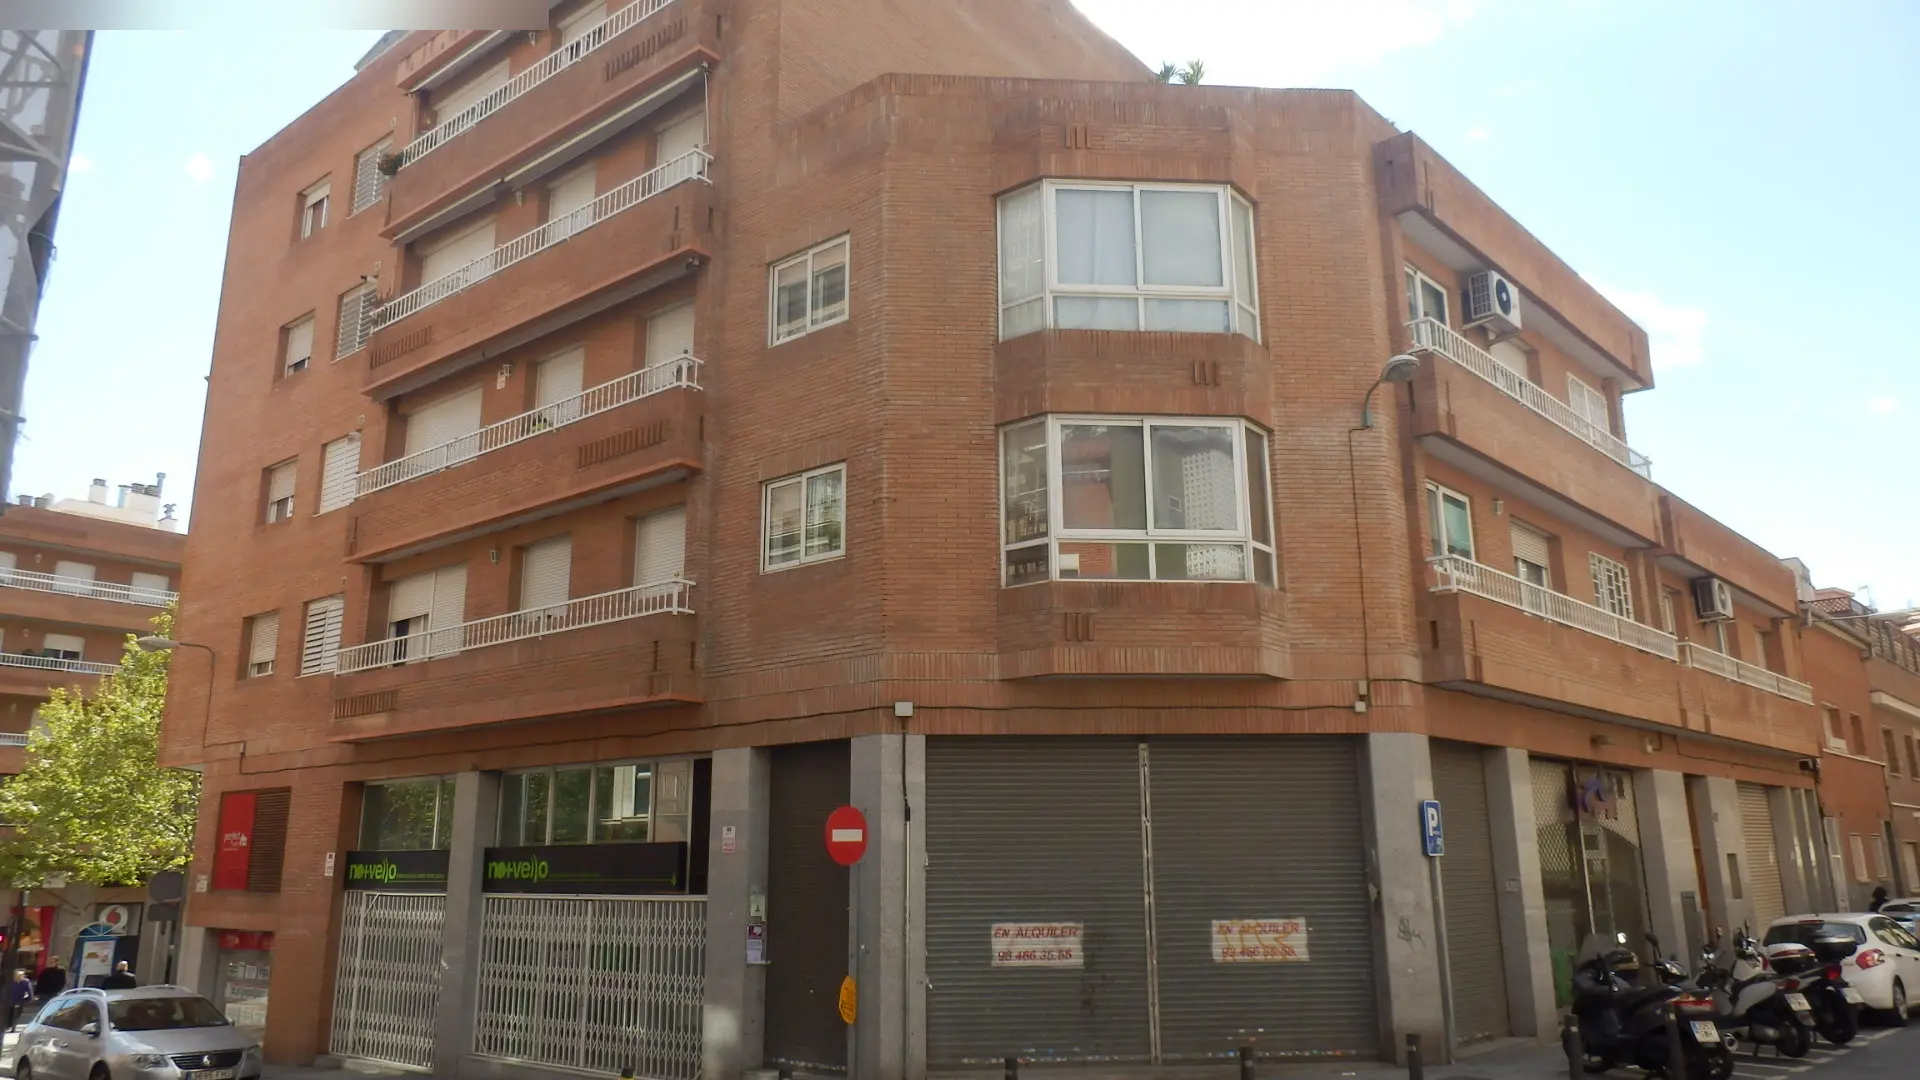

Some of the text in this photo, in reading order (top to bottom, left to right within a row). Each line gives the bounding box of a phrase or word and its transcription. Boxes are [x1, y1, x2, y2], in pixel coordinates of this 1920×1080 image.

[1427, 807, 1438, 836] P
[994, 926, 1078, 938] EN ALQUILER
